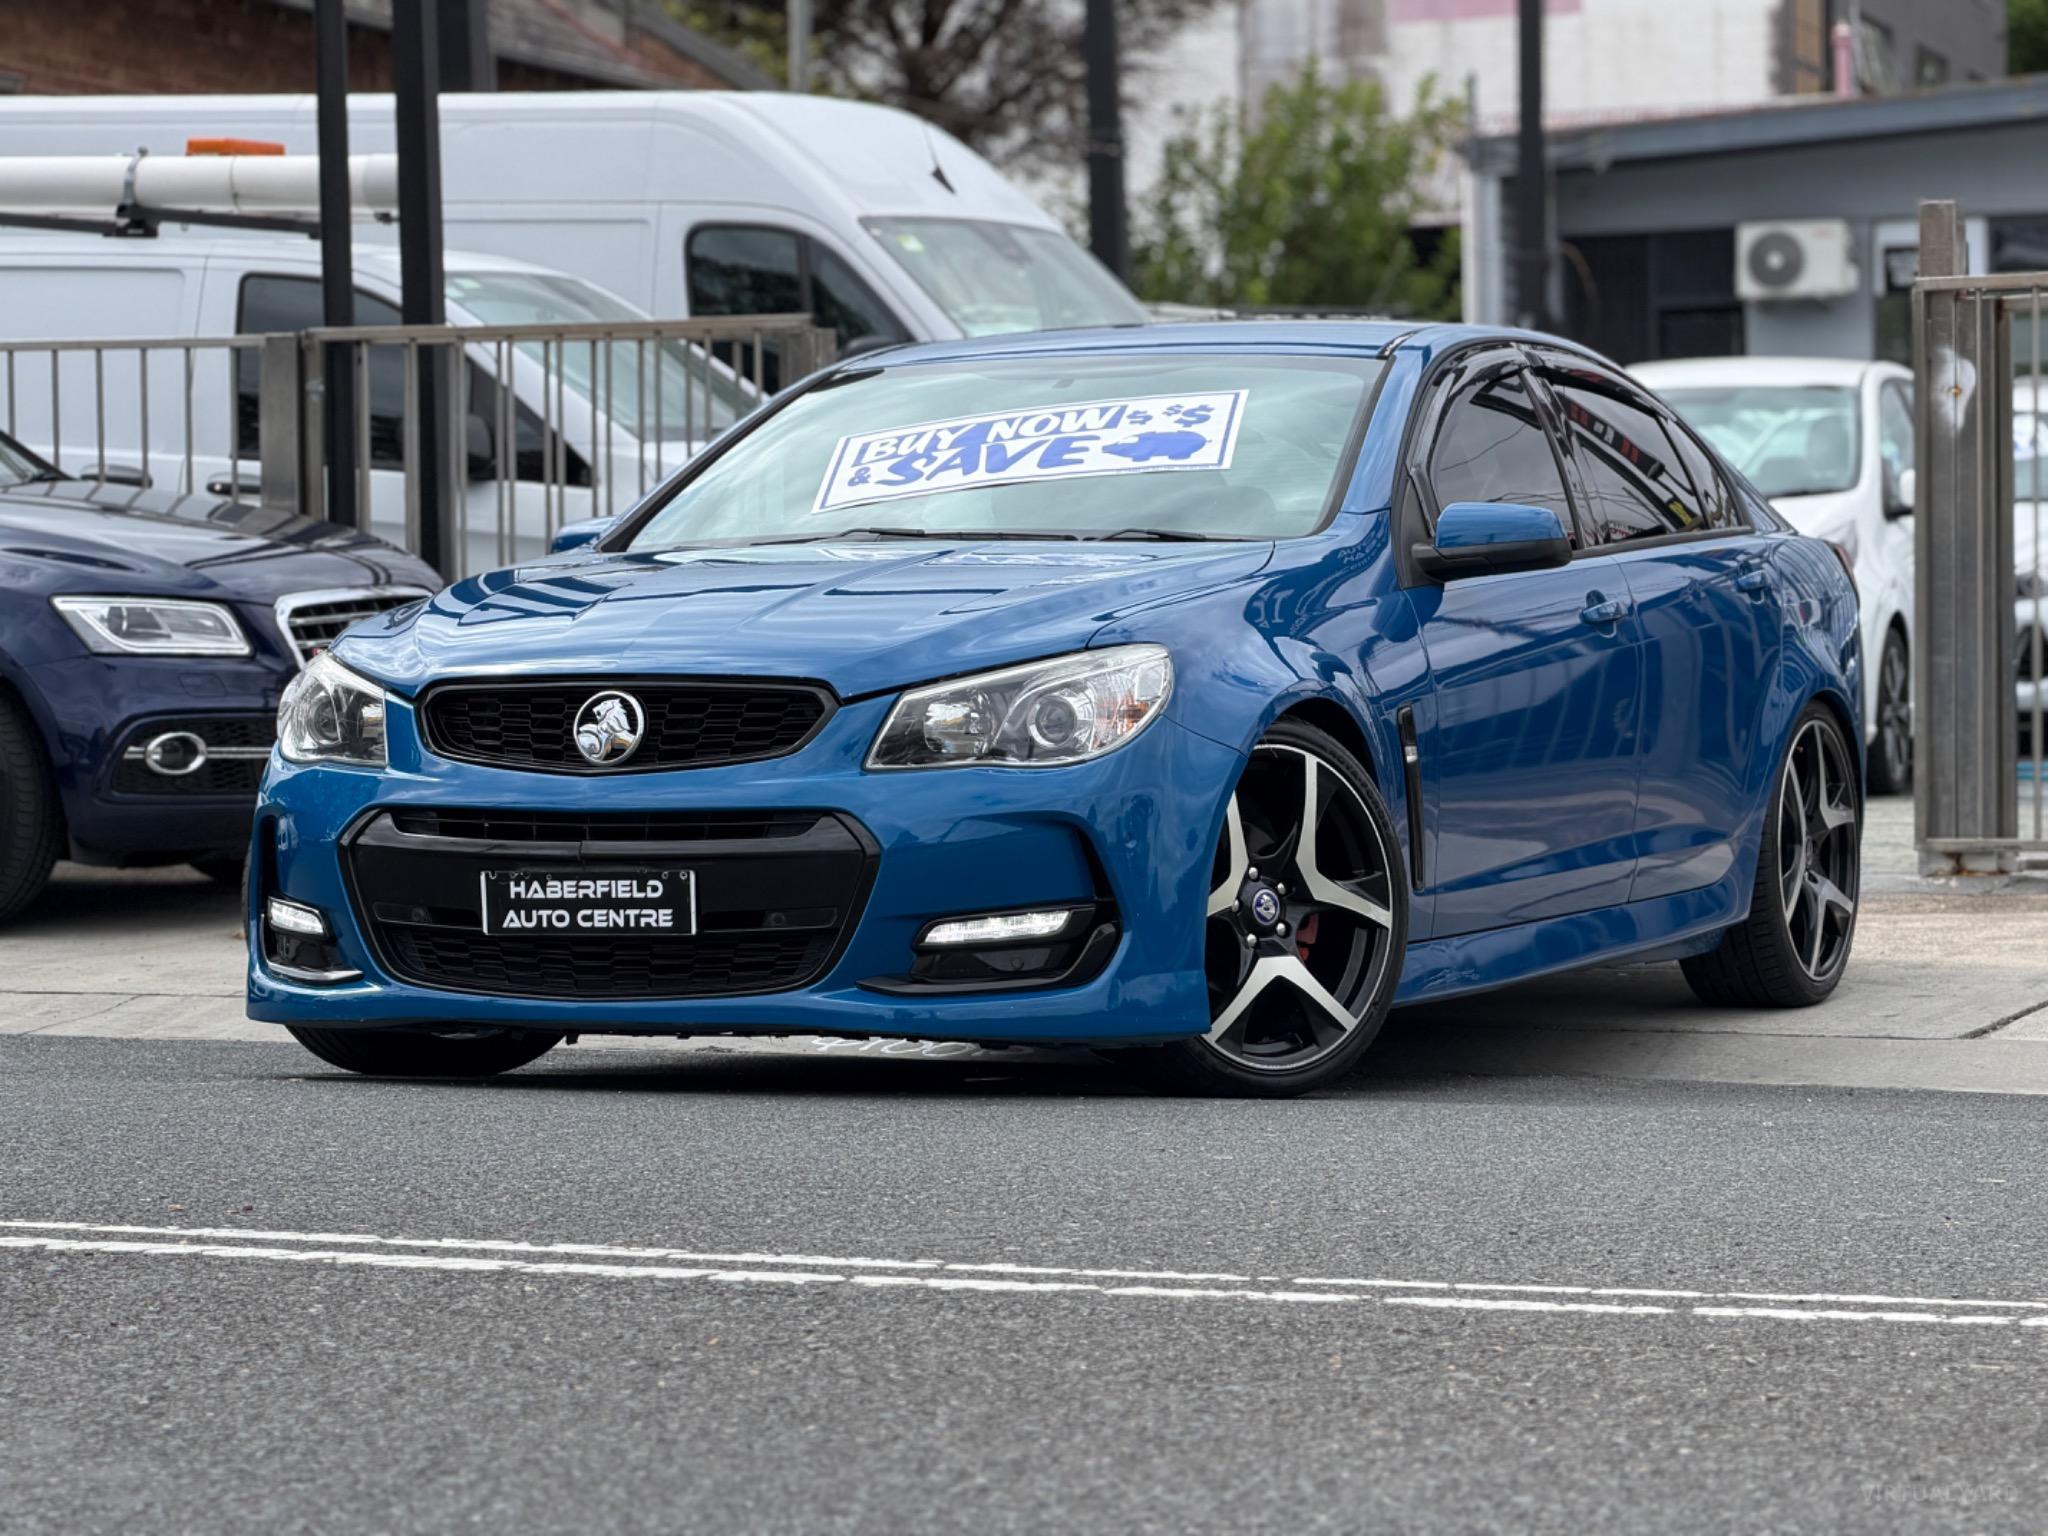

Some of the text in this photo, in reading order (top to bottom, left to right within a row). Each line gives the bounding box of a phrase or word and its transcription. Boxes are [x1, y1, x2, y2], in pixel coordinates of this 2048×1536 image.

[861, 424, 976, 463] BUY
[986, 406, 1121, 442] NOW
[847, 435, 1101, 487] & SAVE
[509, 880, 664, 899] HABERFIELD
[502, 909, 674, 928] AUTO CENTRE
